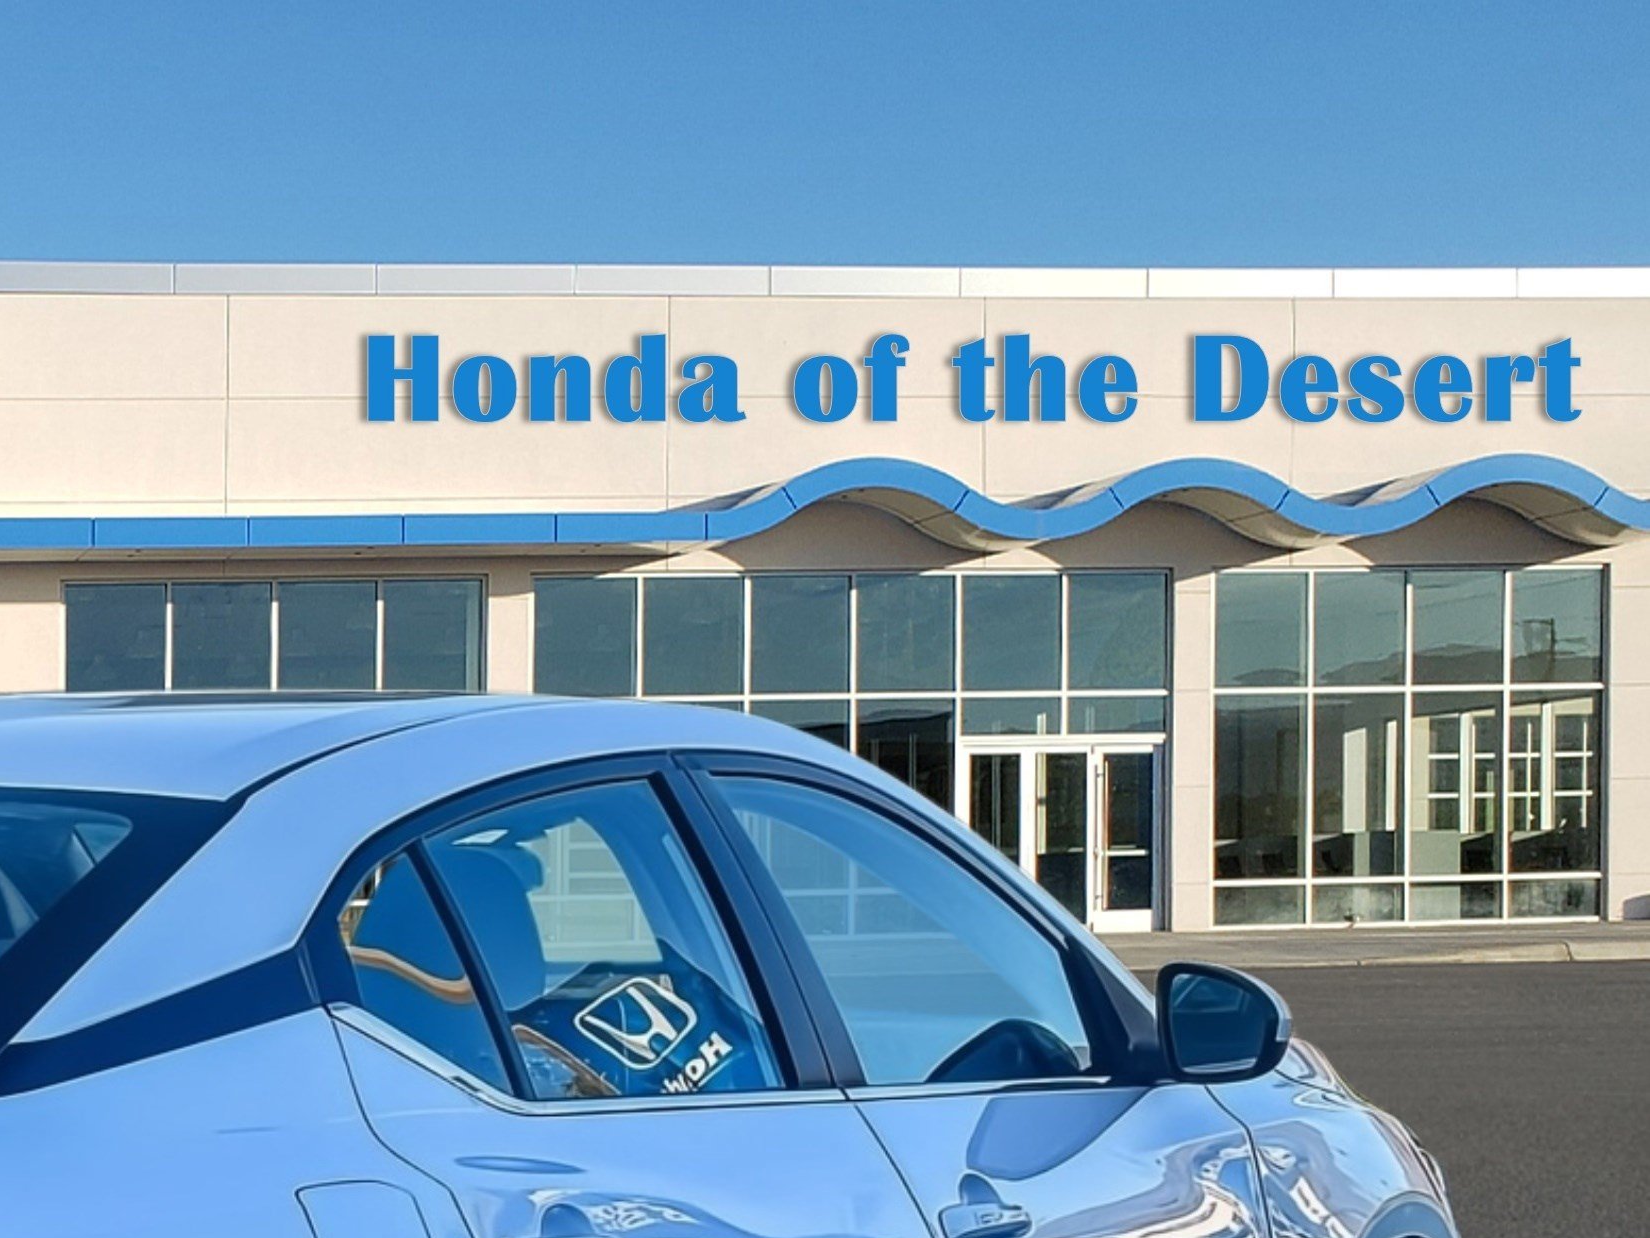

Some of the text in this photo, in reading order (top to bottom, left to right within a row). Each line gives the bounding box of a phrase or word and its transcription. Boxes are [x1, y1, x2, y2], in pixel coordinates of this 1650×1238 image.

[366, 333, 1583, 423] Honda of the Desert
